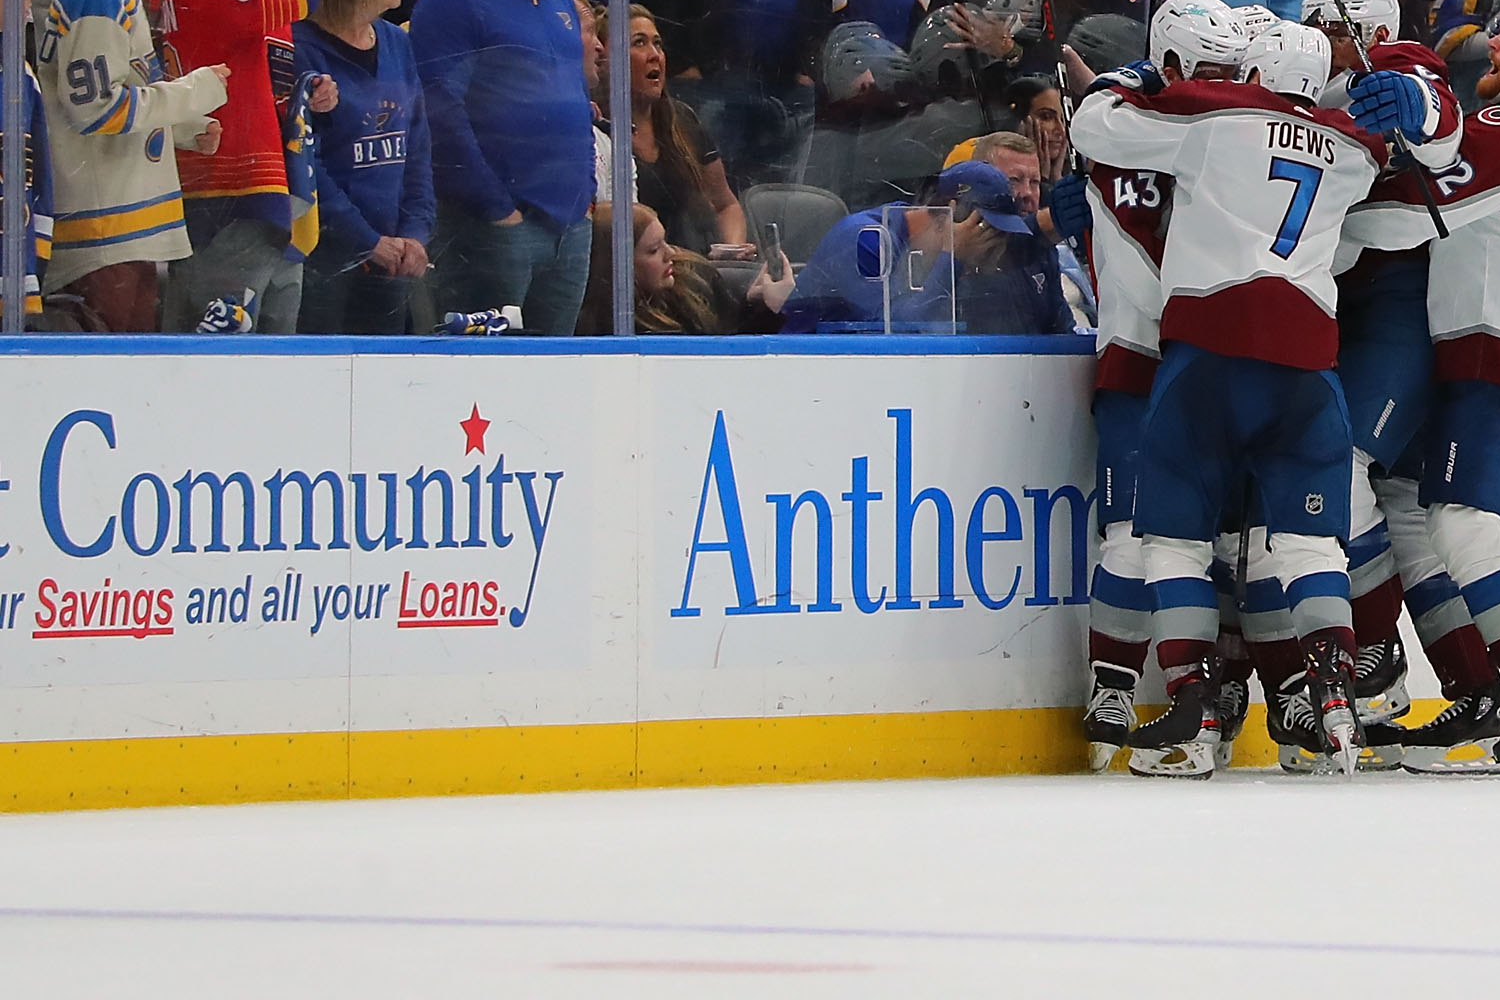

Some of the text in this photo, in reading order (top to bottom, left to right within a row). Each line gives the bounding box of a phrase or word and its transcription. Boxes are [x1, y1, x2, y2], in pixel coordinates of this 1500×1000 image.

[66, 54, 113, 106] 91
[1266, 121, 1336, 165] TOEWS
[1114, 171, 1161, 208] 43
[1267, 155, 1325, 261] 7
[1444, 441, 1459, 483] BAUER
[39, 408, 564, 628] Community
[33, 577, 175, 636] Savings
[186, 574, 252, 624] and
[262, 572, 302, 624] all
[310, 583, 391, 635] your
[397, 570, 508, 624] Loans.
